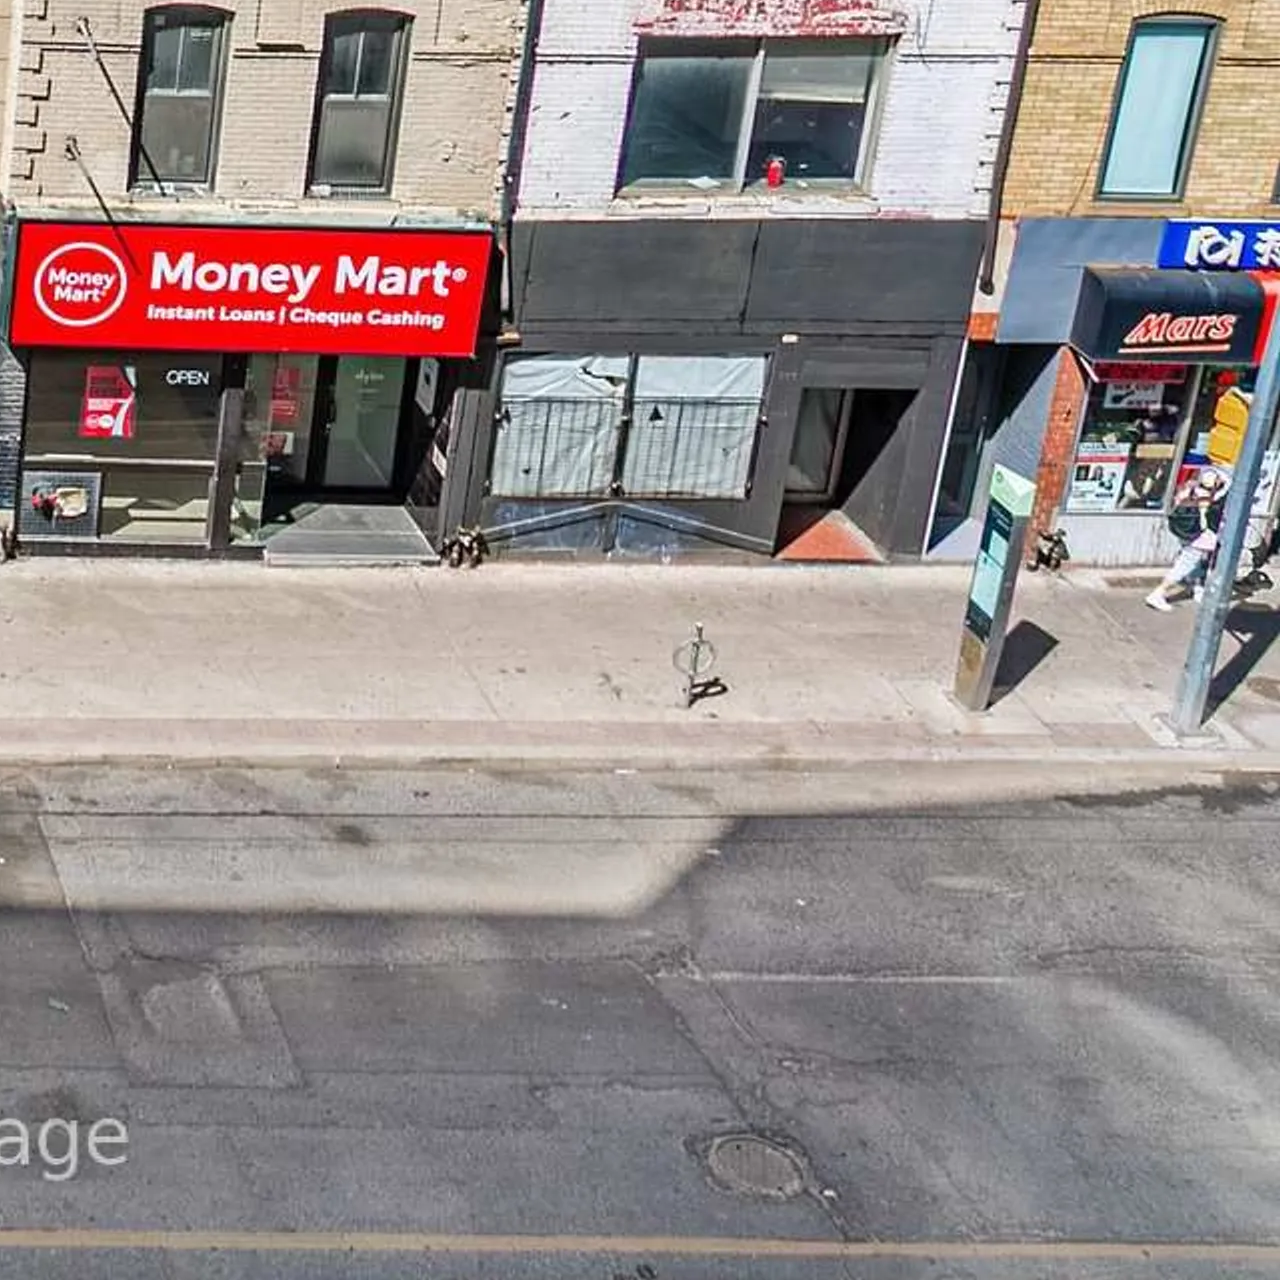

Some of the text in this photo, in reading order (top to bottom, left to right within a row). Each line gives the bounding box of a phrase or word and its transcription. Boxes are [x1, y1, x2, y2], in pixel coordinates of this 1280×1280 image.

[47, 269, 116, 291] Money
[151, 251, 321, 303] Money
[53, 287, 102, 303] Mart
[148, 304, 215, 322] Instant
[219, 306, 275, 323] Loans
[290, 307, 362, 329] Cheque
[367, 310, 445, 332] Cashing
[1125, 311, 1237, 344] Mars
[166, 369, 210, 385] OPEN
